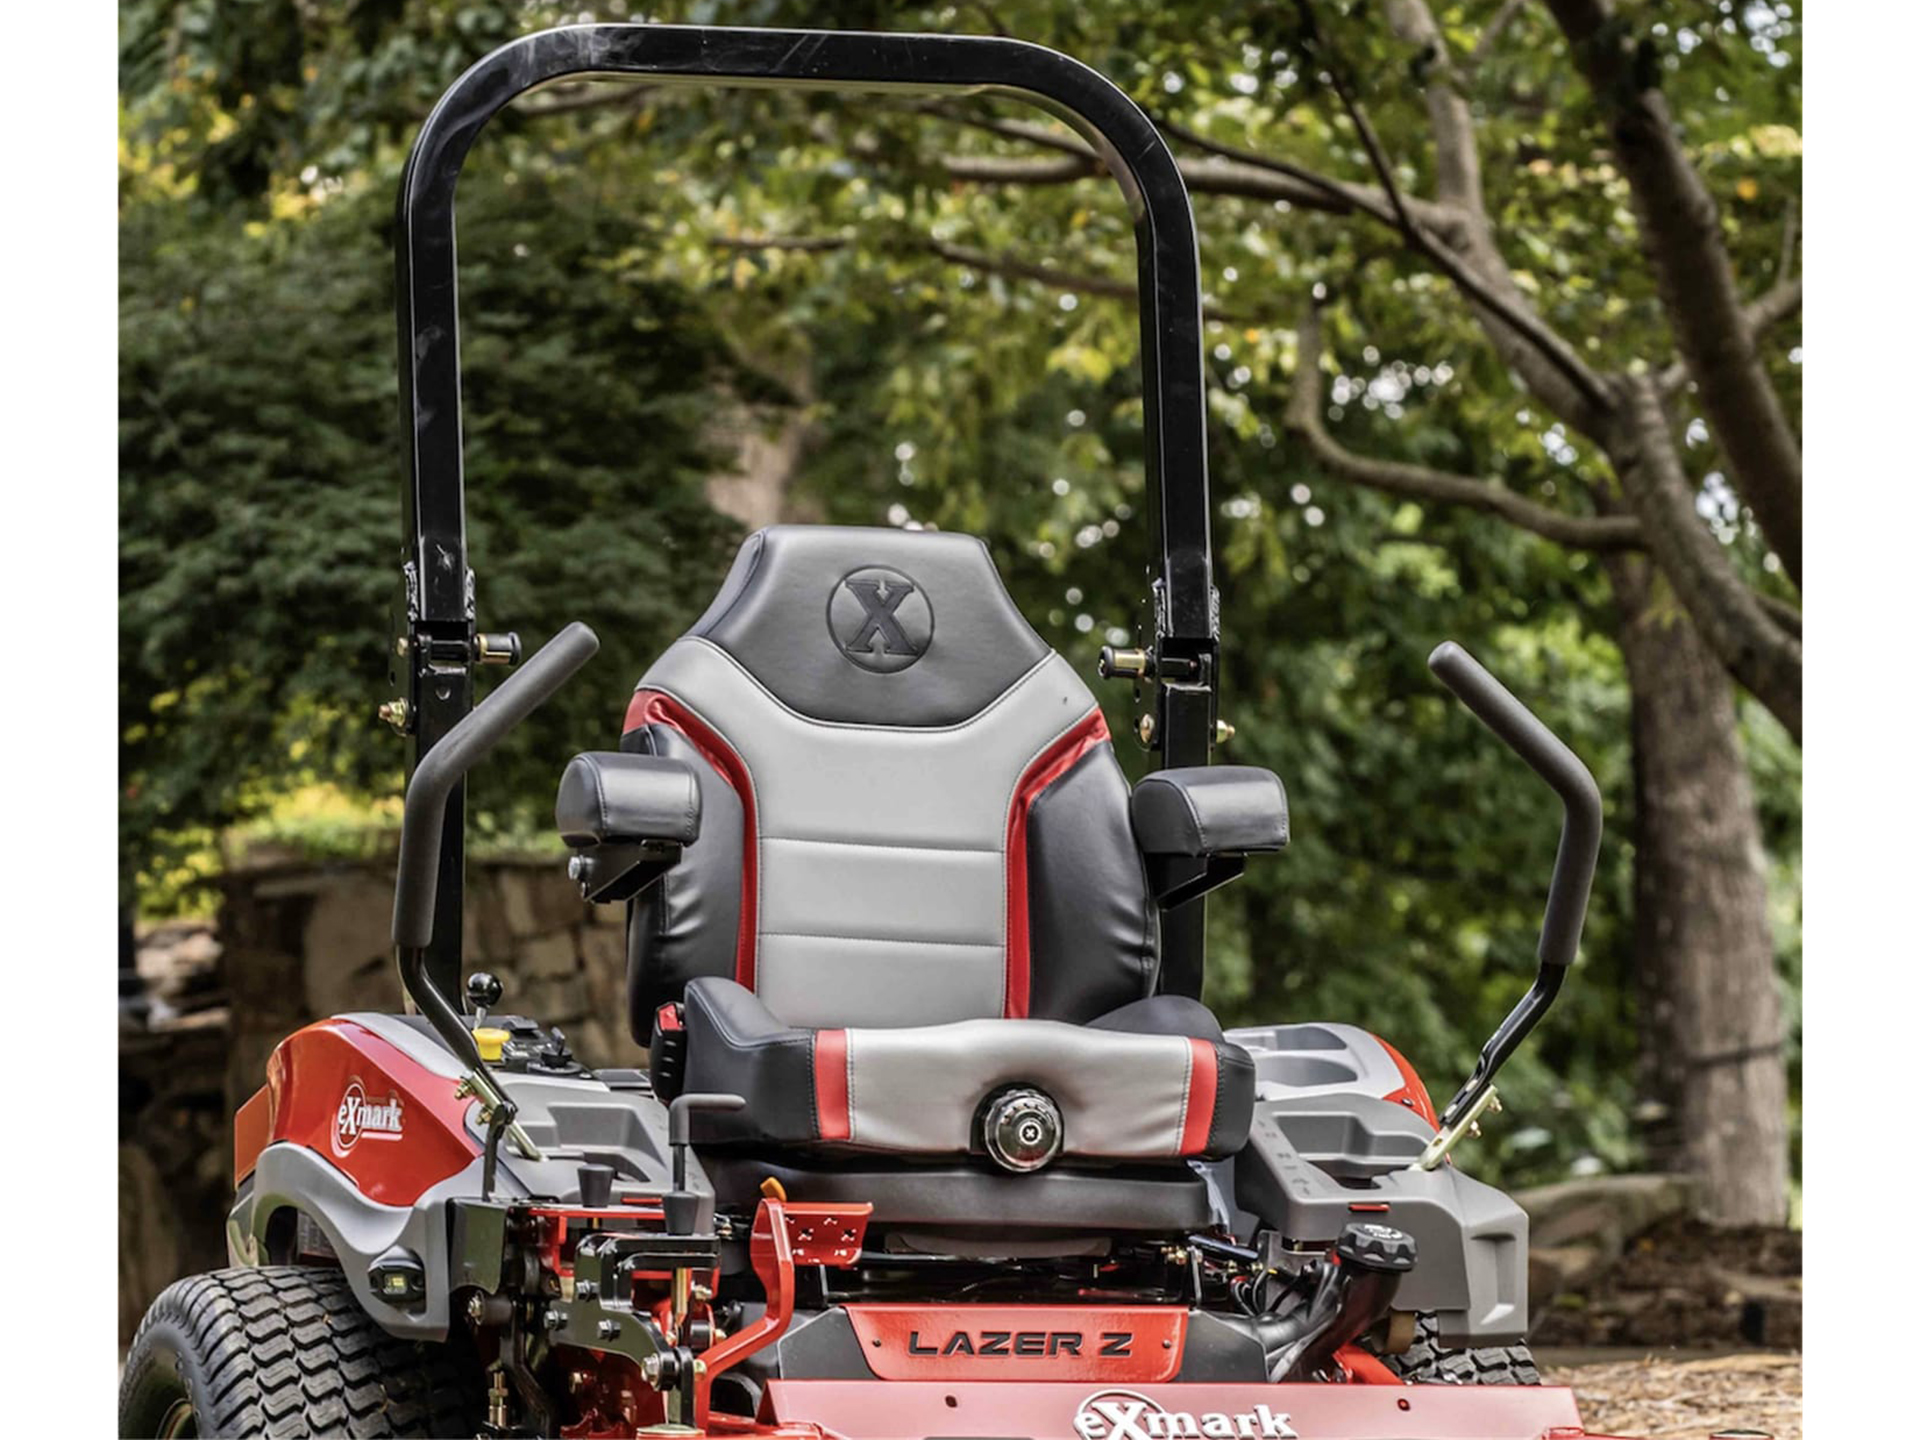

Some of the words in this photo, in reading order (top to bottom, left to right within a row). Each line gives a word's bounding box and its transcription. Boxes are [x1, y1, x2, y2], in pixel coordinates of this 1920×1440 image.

[844, 579, 919, 656] X
[337, 1096, 403, 1135] eXmark
[908, 1330, 1083, 1356] LAZER
[1100, 1331, 1133, 1356] Z
[1074, 1400, 1298, 1440] eXmark
